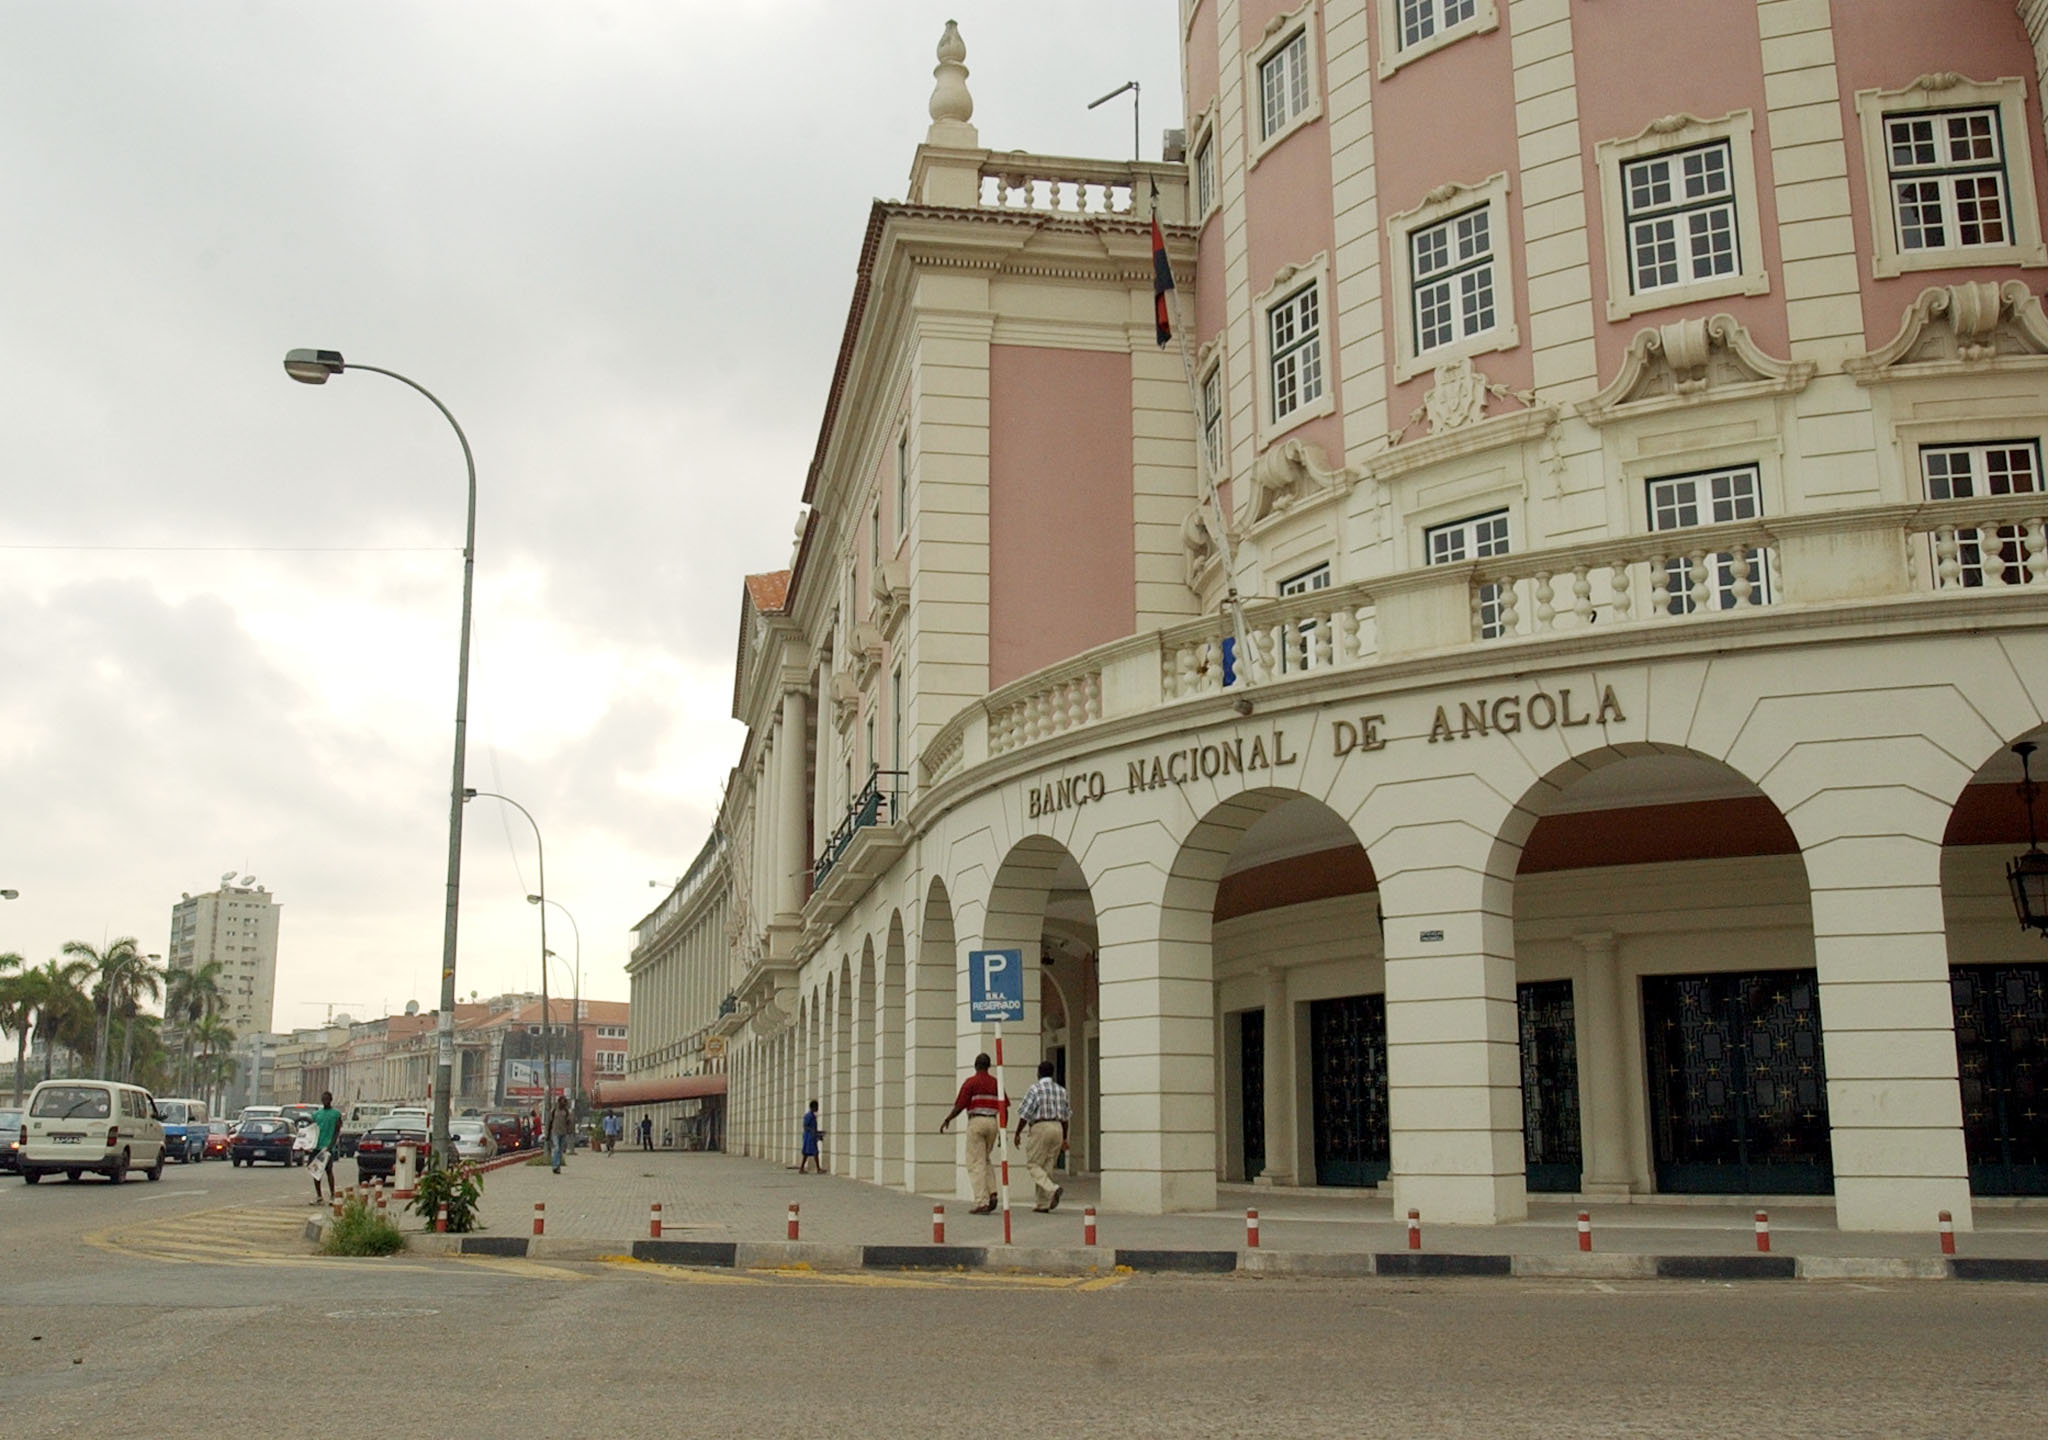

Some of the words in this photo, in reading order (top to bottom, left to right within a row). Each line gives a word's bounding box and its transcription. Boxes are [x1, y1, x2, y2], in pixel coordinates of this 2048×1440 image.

[1028, 771, 1106, 819] BANCO
[1127, 731, 1297, 794] NACIONAL
[1332, 714, 1387, 757] DE
[1428, 684, 1627, 742] ANGOLA
[984, 954, 1007, 991] P
[972, 1000, 1021, 1011] RESERVADO
